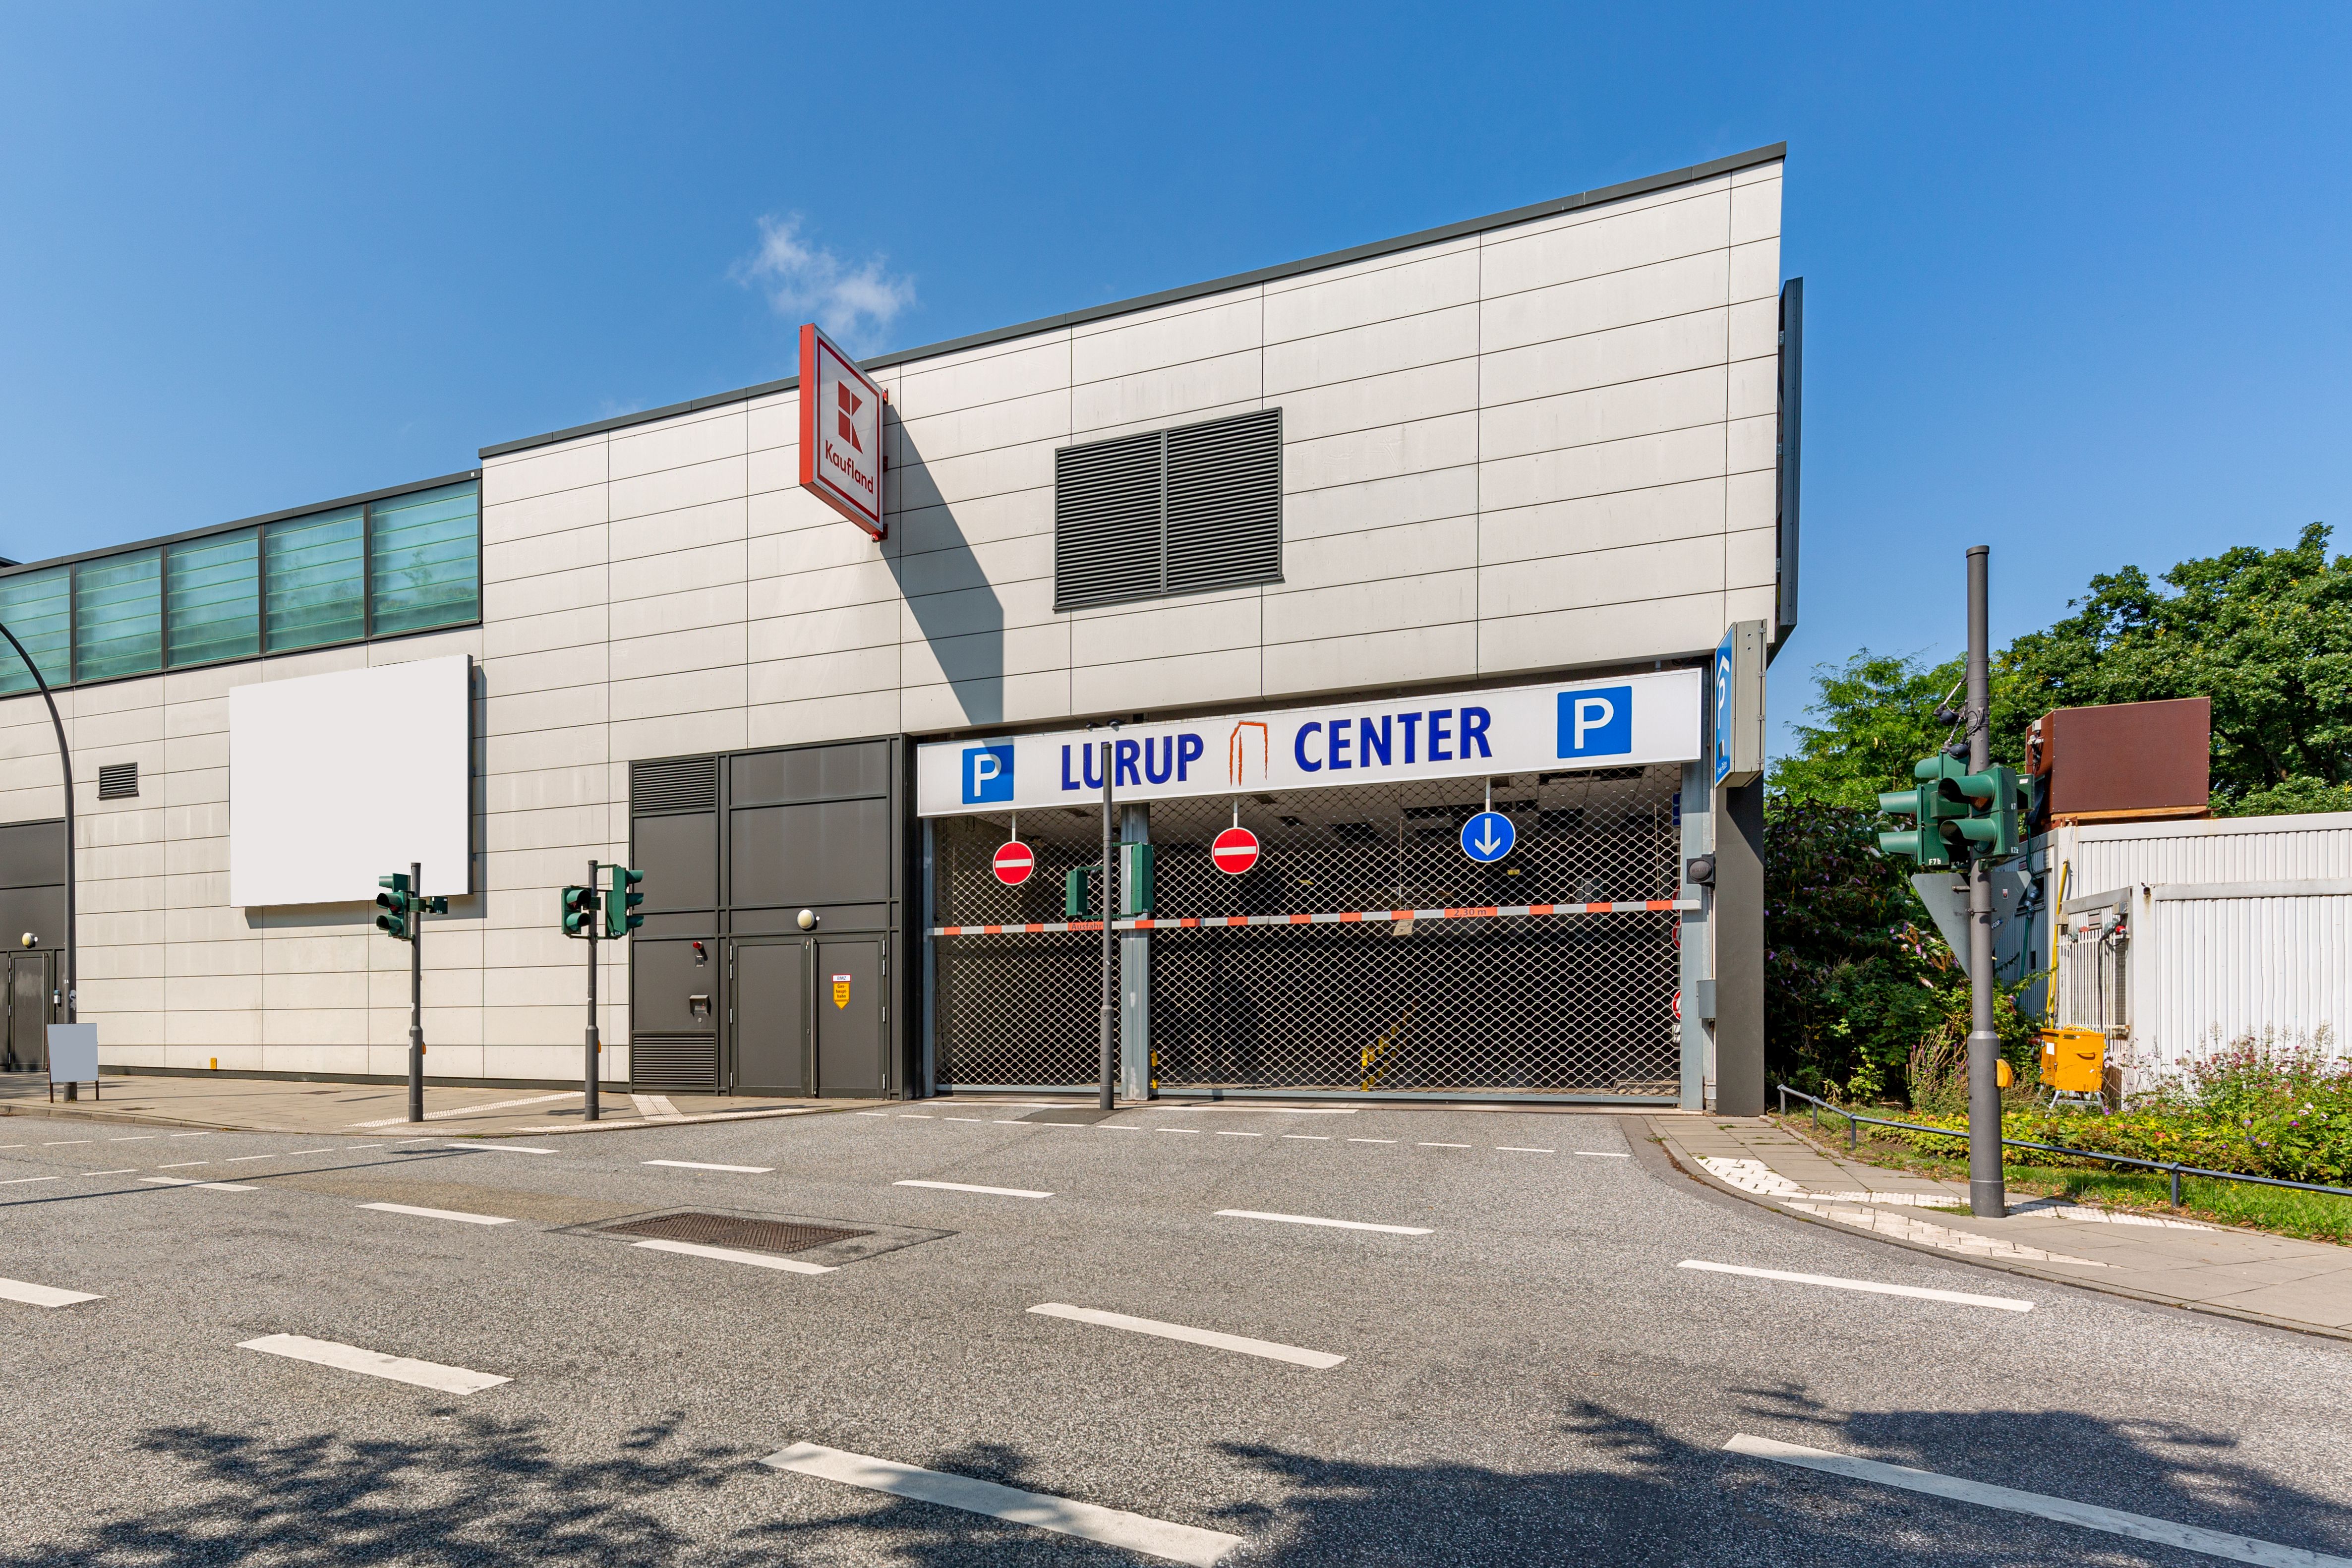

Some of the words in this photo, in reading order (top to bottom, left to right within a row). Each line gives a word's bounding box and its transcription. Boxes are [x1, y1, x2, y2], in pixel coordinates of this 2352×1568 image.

[825, 439, 874, 495] Kaufland
[1061, 733, 1204, 791] LURUP
[1294, 706, 1492, 772] CENTER
[1574, 697, 1615, 749] P
[974, 754, 1002, 797] P
[1454, 909, 1474, 917] 2,30
